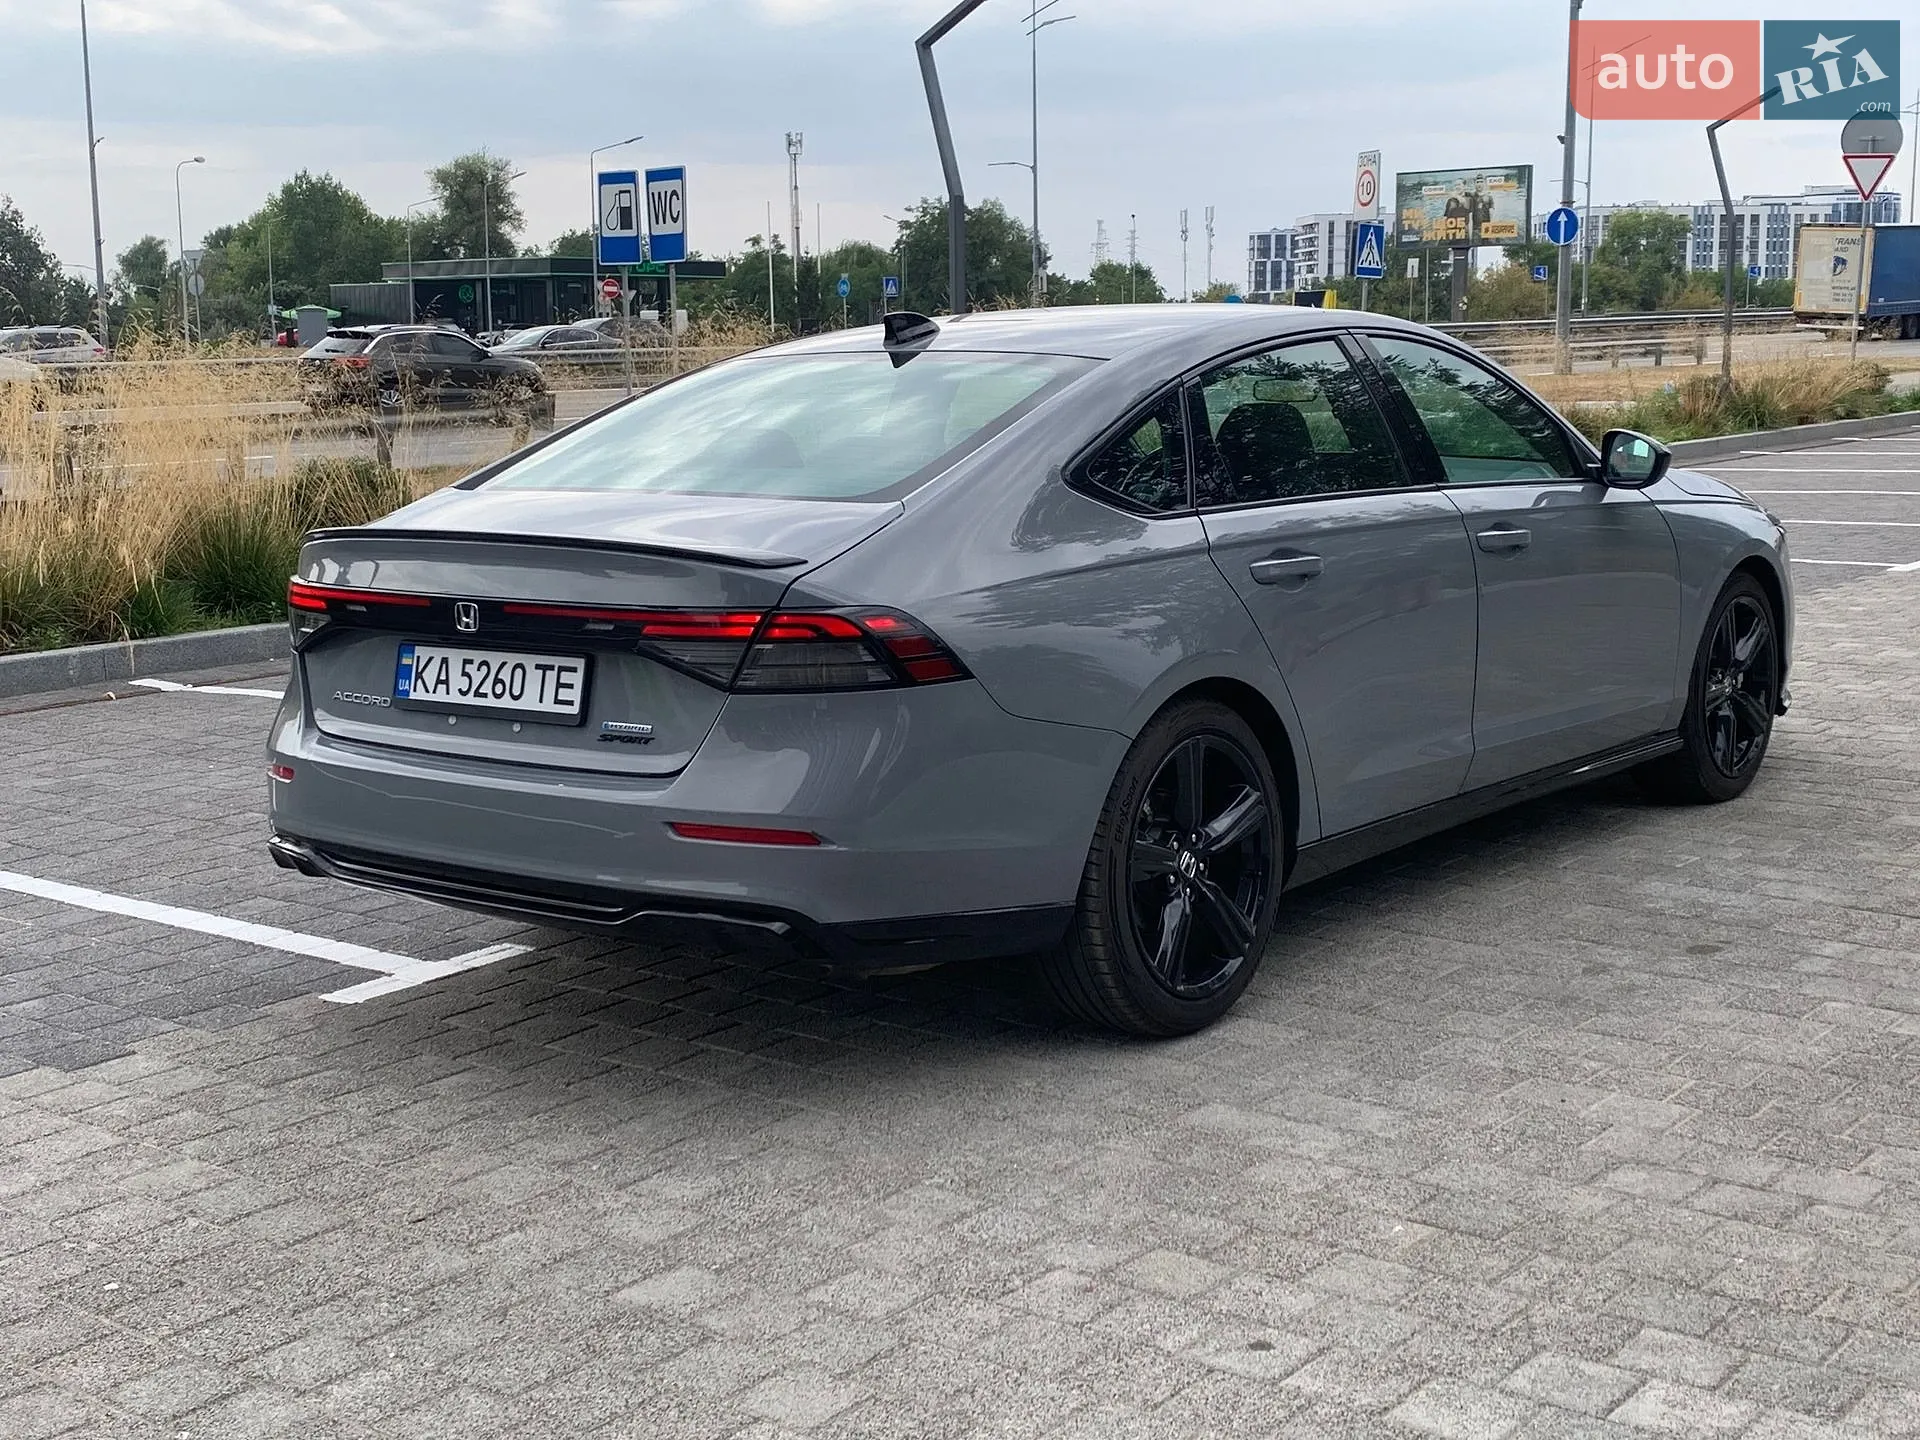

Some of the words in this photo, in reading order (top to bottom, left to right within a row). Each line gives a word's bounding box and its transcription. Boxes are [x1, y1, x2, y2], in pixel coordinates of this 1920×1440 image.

[1359, 153, 1377, 168] ЗОНА
[1360, 180, 1372, 196] 10
[651, 189, 680, 225] WC
[398, 678, 411, 692] UA
[412, 655, 451, 696] KA
[457, 658, 527, 702] 5260
[534, 663, 579, 707] TE
[332, 690, 393, 708] ACCORD
[596, 733, 656, 745] SPORT
